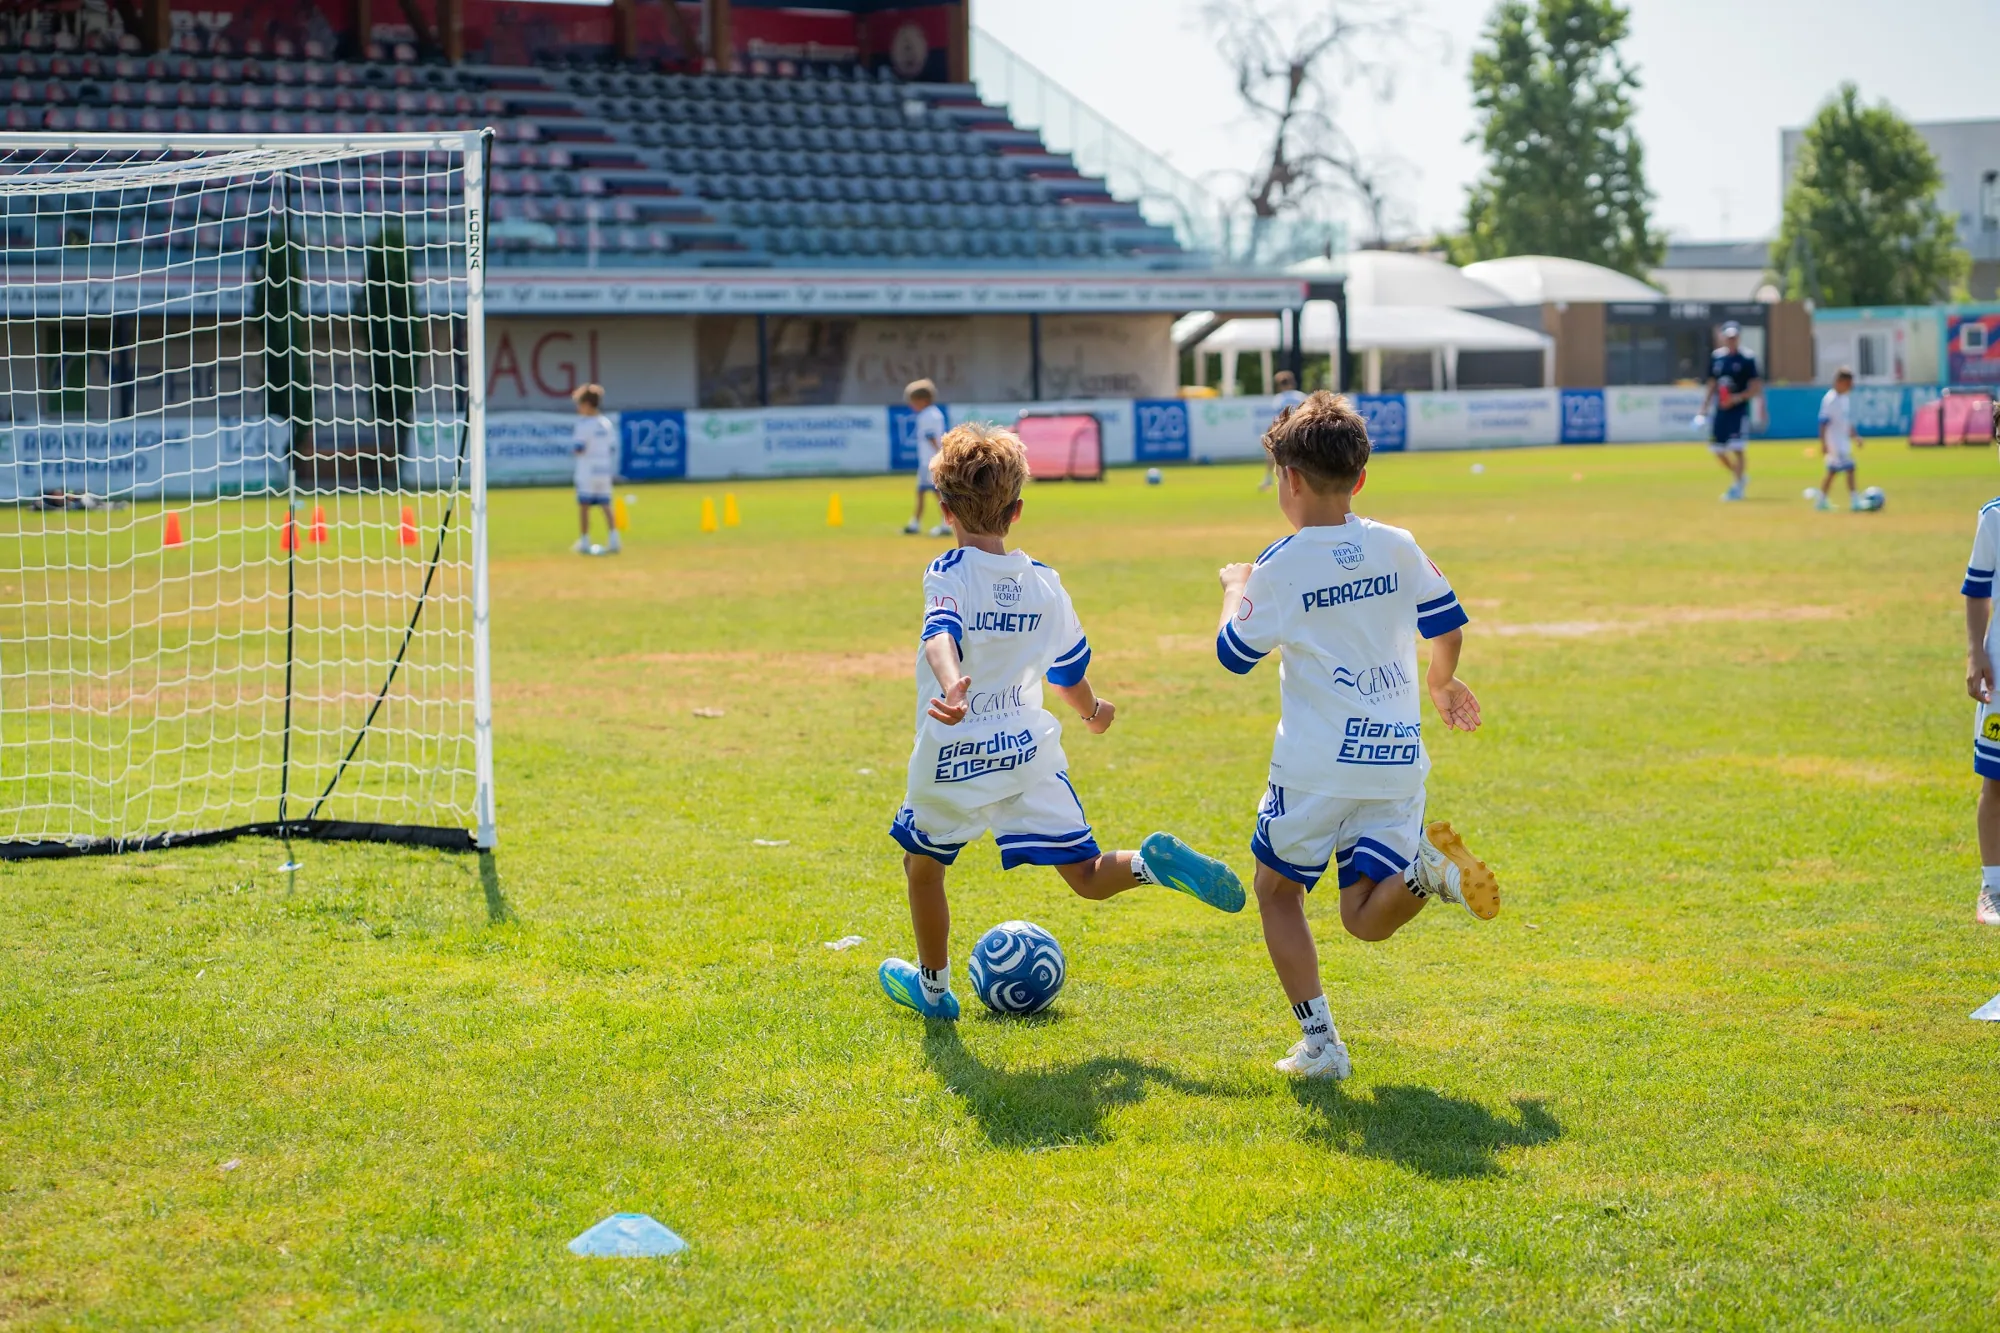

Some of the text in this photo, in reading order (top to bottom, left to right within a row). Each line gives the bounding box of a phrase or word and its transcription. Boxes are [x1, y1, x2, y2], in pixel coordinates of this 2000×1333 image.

[469, 208, 480, 270] FORZA
[1332, 545, 1363, 557] REPLAY
[1336, 553, 1365, 565] WORLD
[992, 583, 1023, 593] REPLAY
[1302, 572, 1398, 612] PERAZZOLI
[938, 729, 1034, 762] Giardina
[1336, 739, 1420, 765] Energi
[934, 745, 1038, 783] Energie
